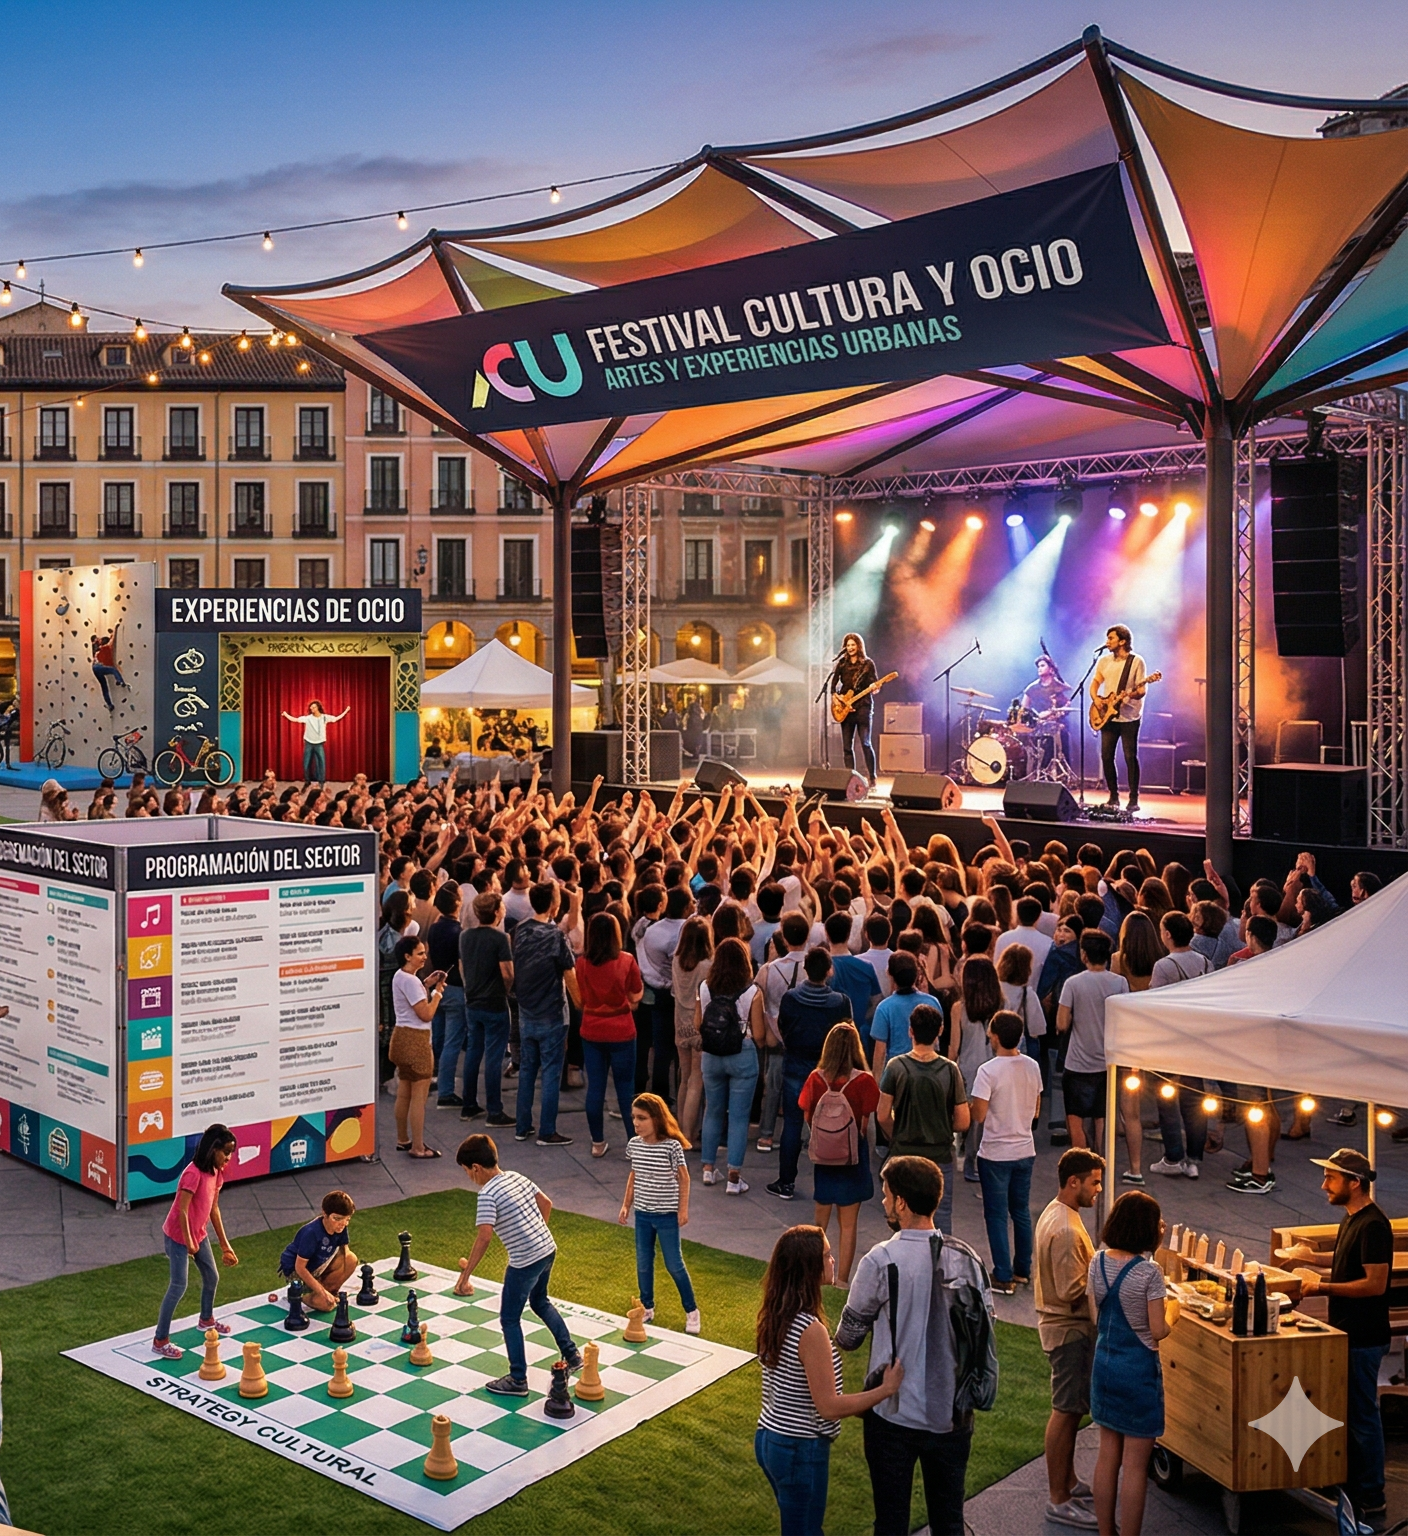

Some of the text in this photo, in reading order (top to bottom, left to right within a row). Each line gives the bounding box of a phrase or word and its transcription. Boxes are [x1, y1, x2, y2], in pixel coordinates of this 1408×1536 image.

[585, 238, 1084, 364] FESTIVAL CULTURA Y OCIO
[604, 314, 963, 391] ARTES Y EXPERIENCIAS URBANAS
[171, 598, 405, 623] EXPERIENCIAS DE OCIO
[72, 851, 109, 879] SECTOR
[144, 843, 362, 881] PROGRAMACIÓN DEL SECTOR
[145, 1376, 380, 1486] STRATEGY CULTURAL
